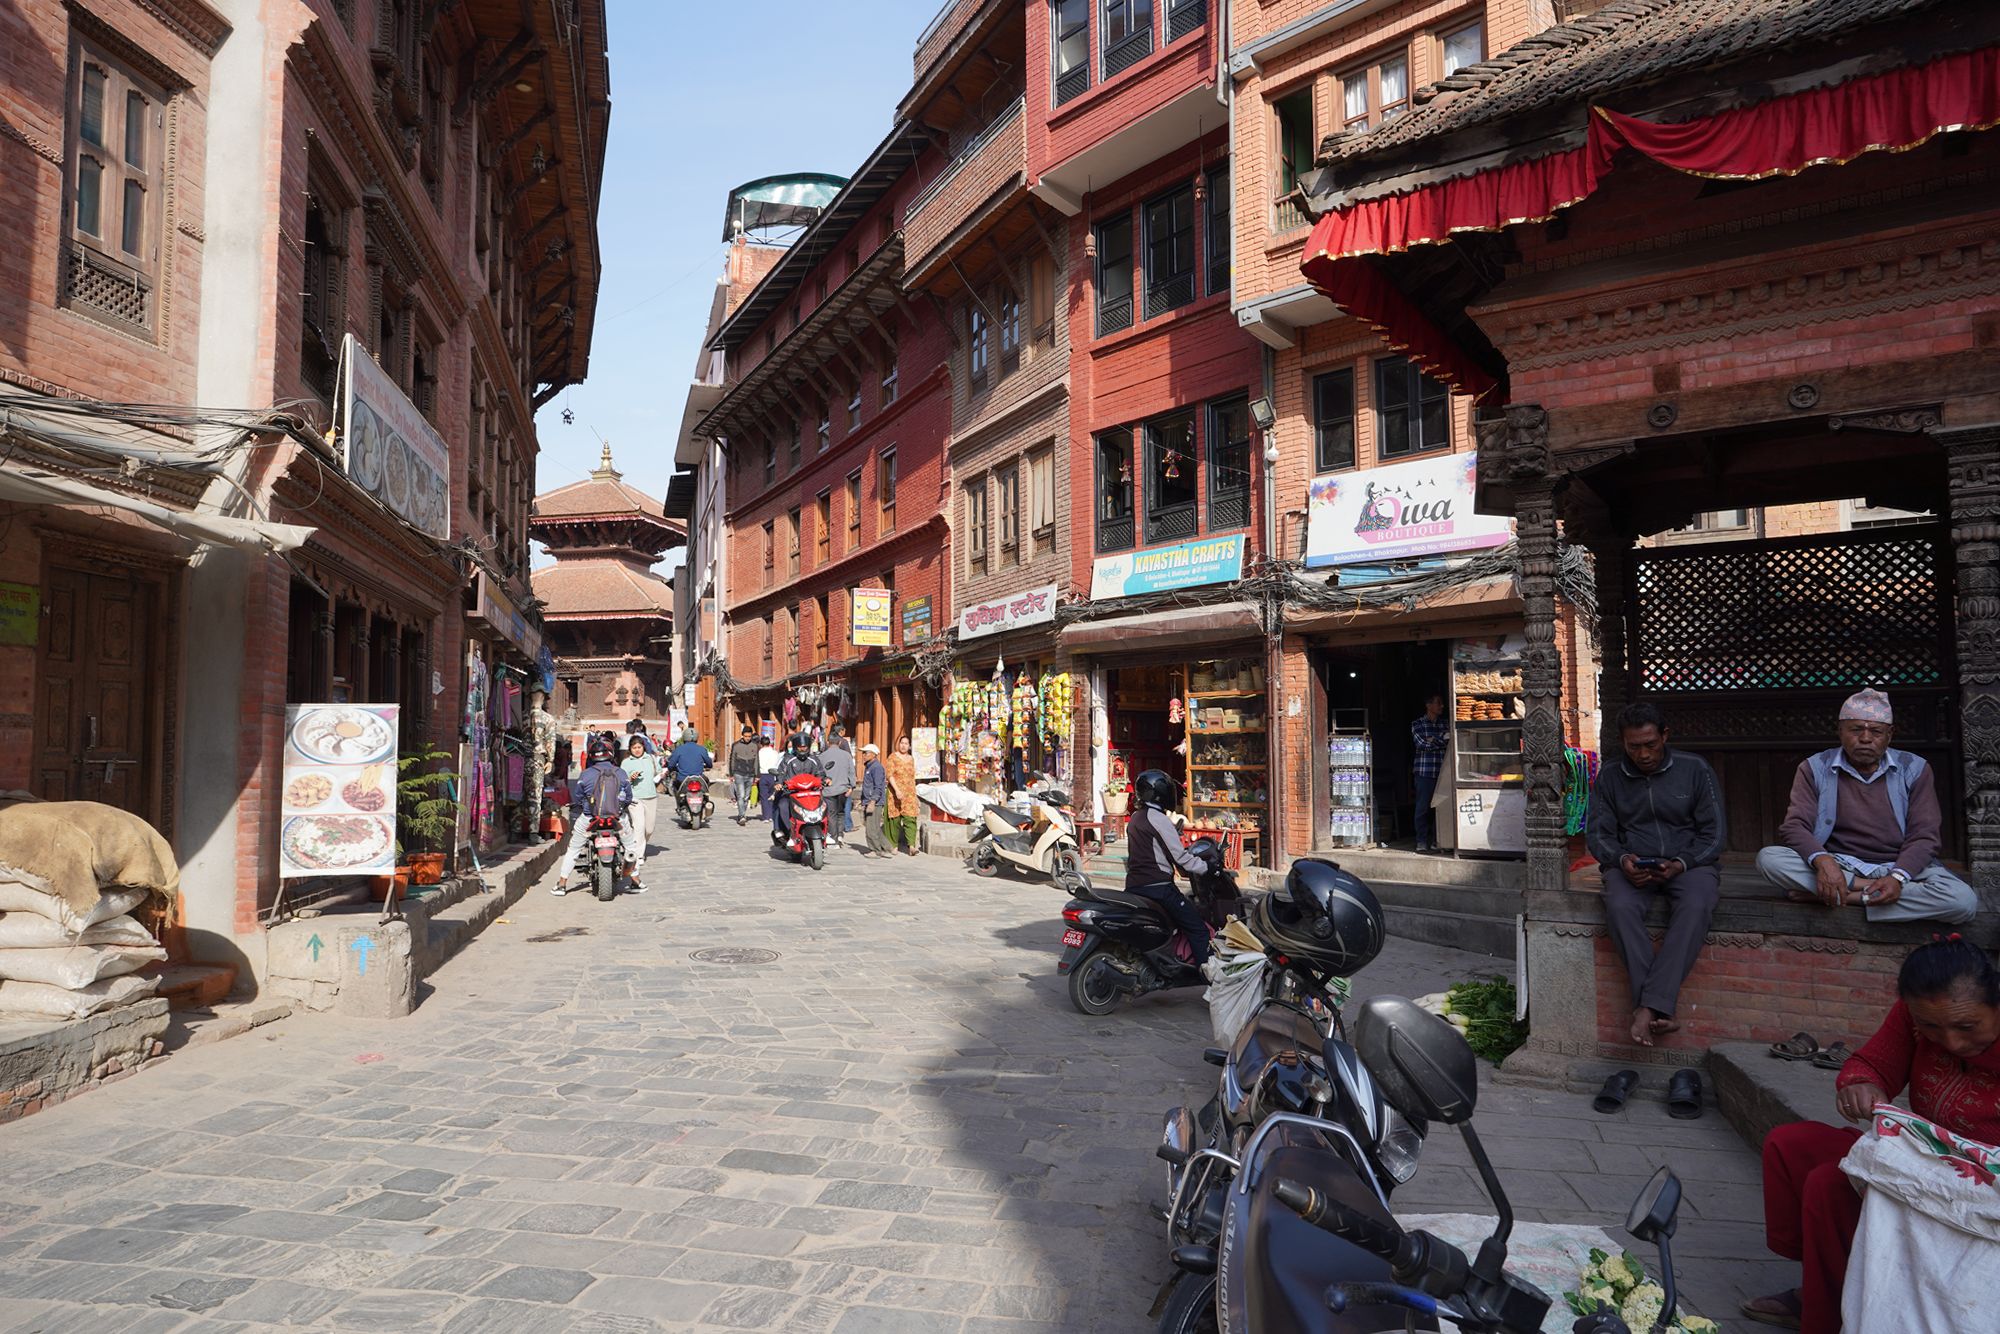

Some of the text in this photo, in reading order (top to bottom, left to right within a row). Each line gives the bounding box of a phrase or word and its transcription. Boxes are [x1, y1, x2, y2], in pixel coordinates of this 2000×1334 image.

[1377, 522, 1446, 541] BOUTIQUE
[1135, 548, 1189, 574] KAYASTHA
[1192, 539, 1236, 566] CRAFTS
[1010, 592, 1048, 619] स्टोर
